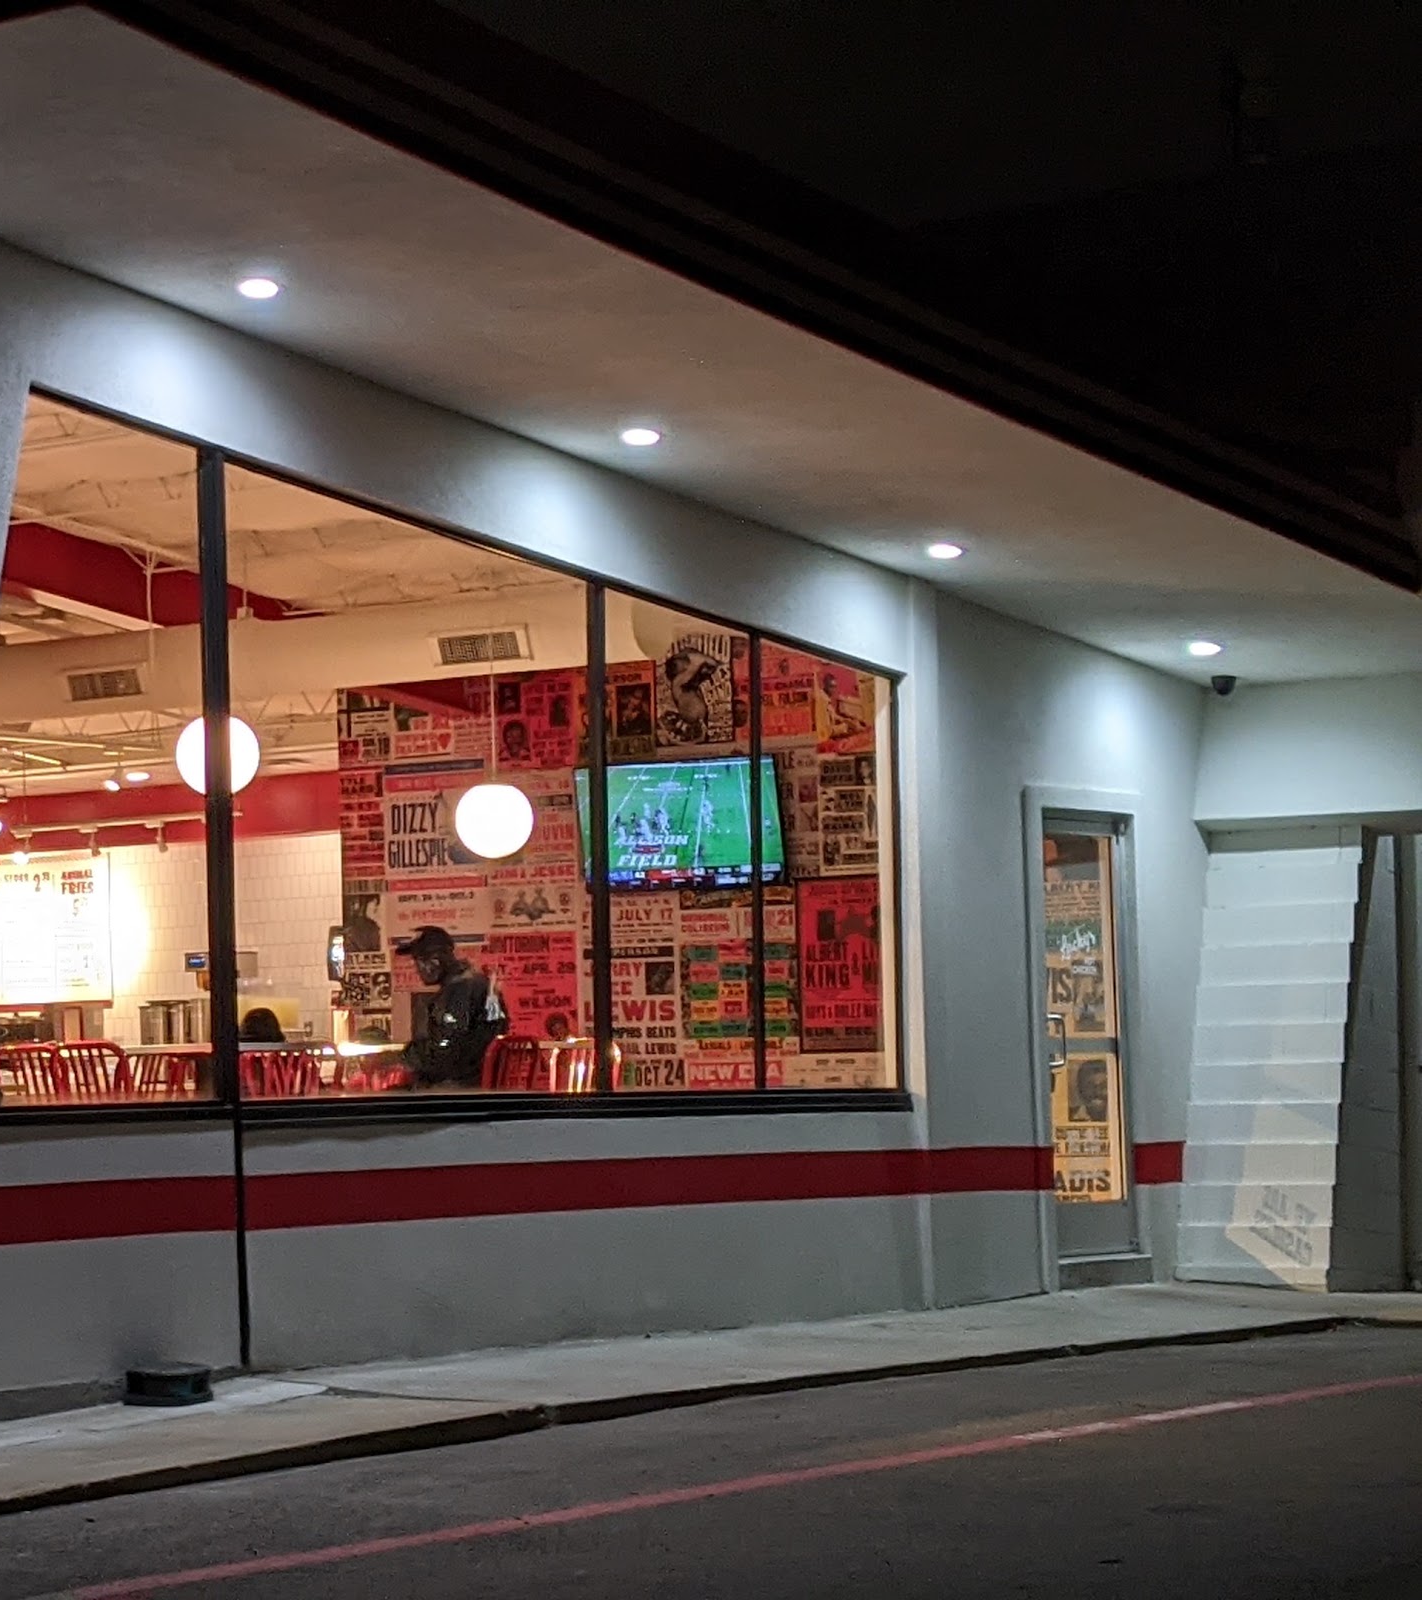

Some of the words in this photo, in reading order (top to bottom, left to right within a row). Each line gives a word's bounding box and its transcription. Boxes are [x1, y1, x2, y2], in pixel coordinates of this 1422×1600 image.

[390, 800, 440, 835] DIZZY
[388, 838, 449, 869] GILLESPIE
[617, 907, 652, 922] JULY
[805, 963, 850, 989] KING
[646, 1025, 676, 1038] BEATS
[645, 1042, 676, 1055] LEWIS
[664, 1059, 685, 1086] 24
[690, 1066, 734, 1081] NEW
